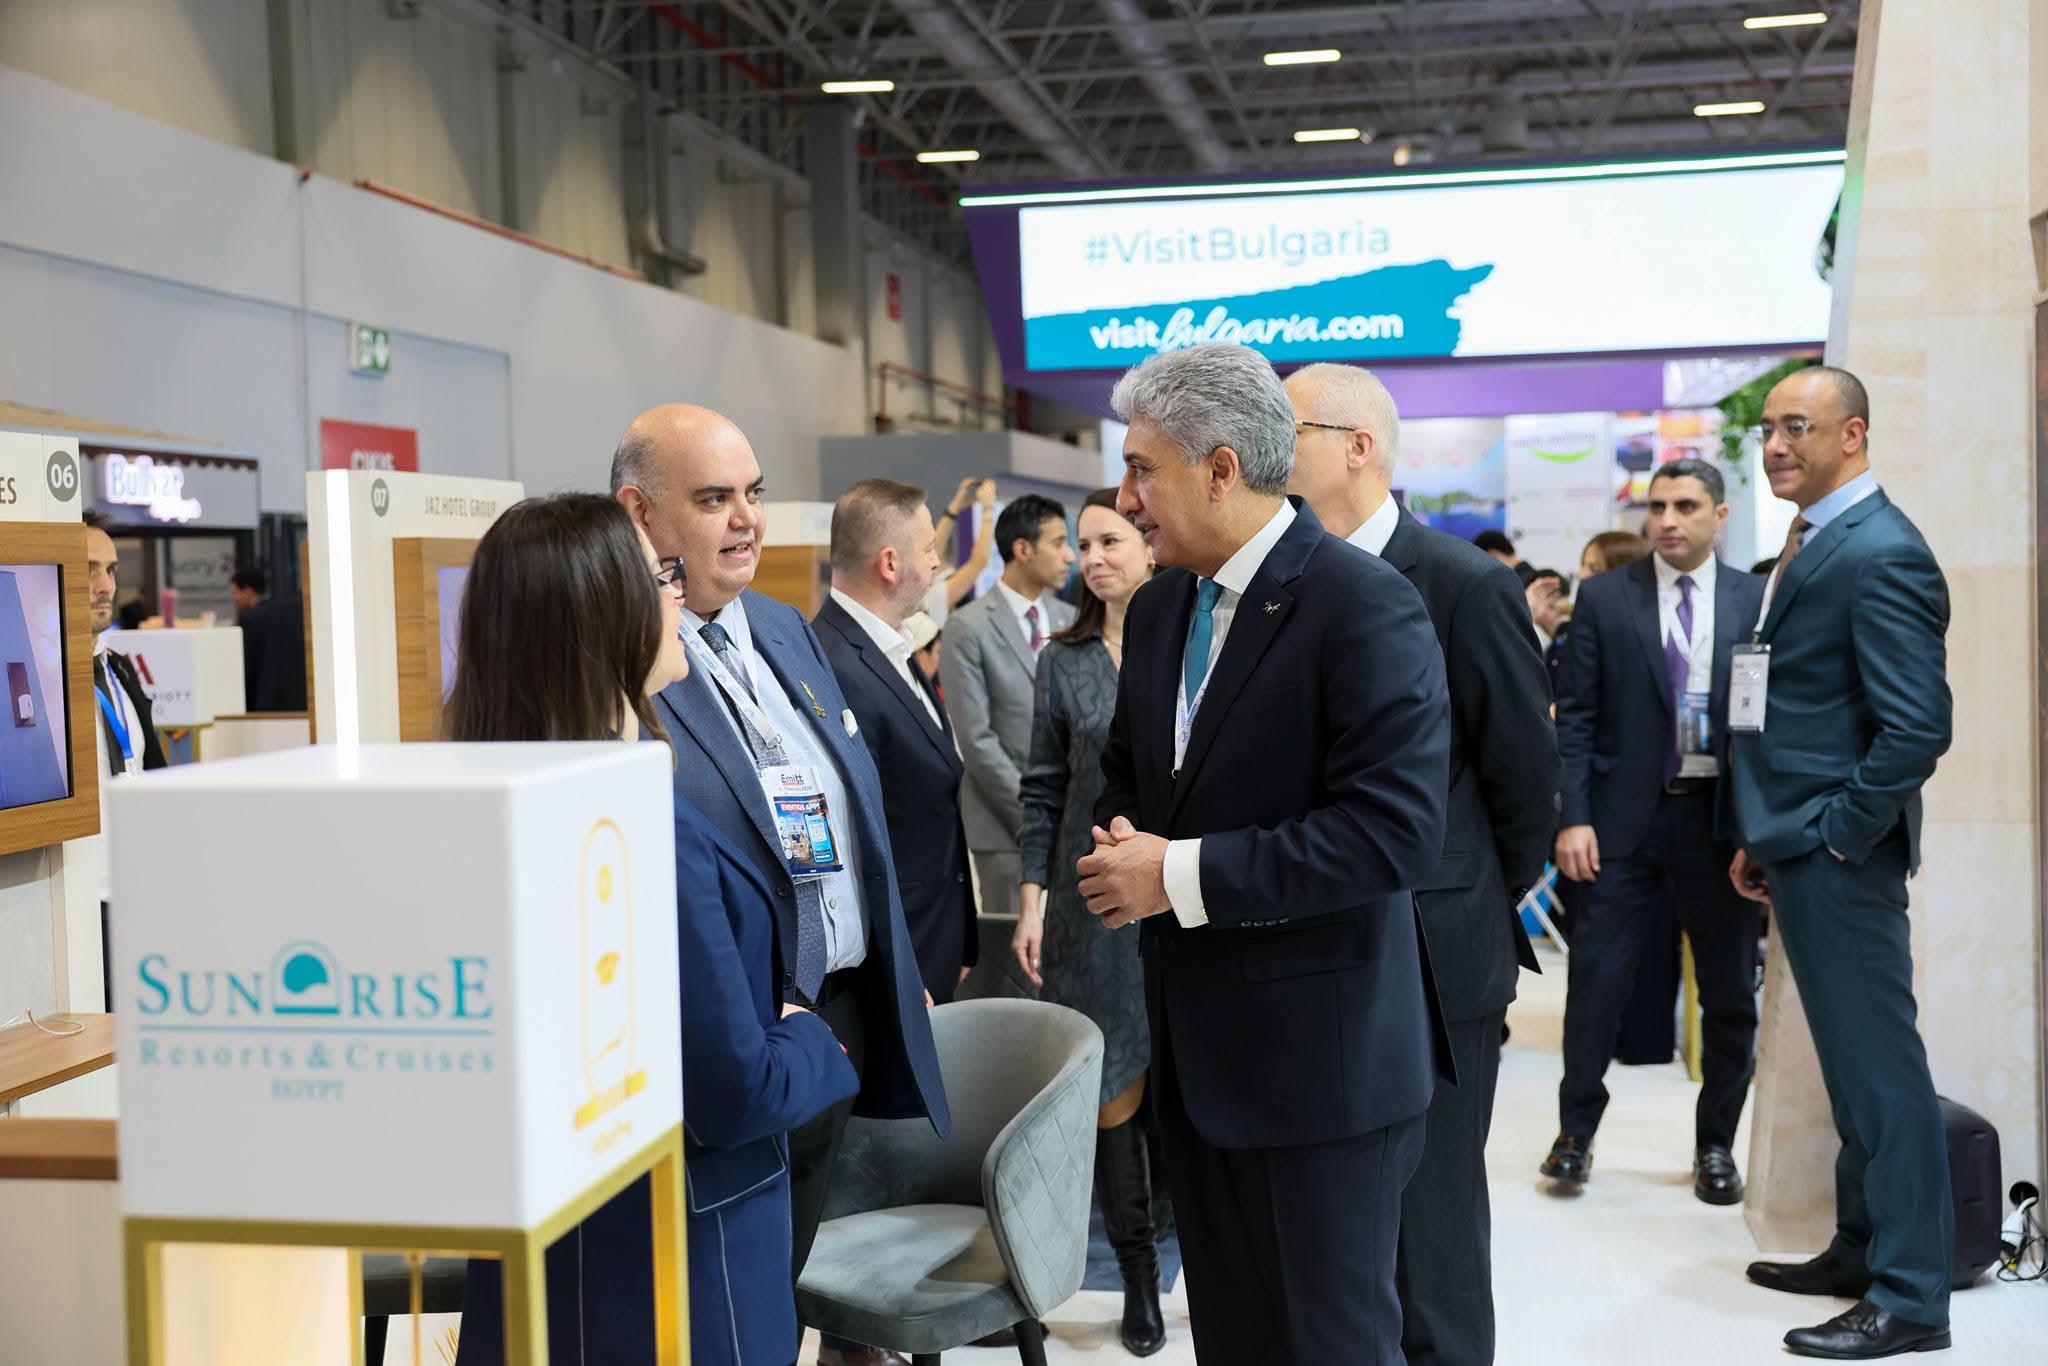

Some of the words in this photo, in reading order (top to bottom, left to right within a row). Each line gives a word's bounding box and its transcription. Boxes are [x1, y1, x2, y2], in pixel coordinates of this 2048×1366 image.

[1084, 221, 1391, 266] #VisitBulgaria
[51, 463, 75, 488] 06
[424, 496, 440, 514] JAZ
[442, 497, 468, 516] HOTEL
[470, 499, 496, 518] GROUP
[781, 773, 804, 783] Emitt
[140, 1038, 293, 1069] Resorts
[306, 1042, 331, 1069] &
[345, 1040, 494, 1073] Cruises
[271, 1079, 344, 1099] EGYPT
